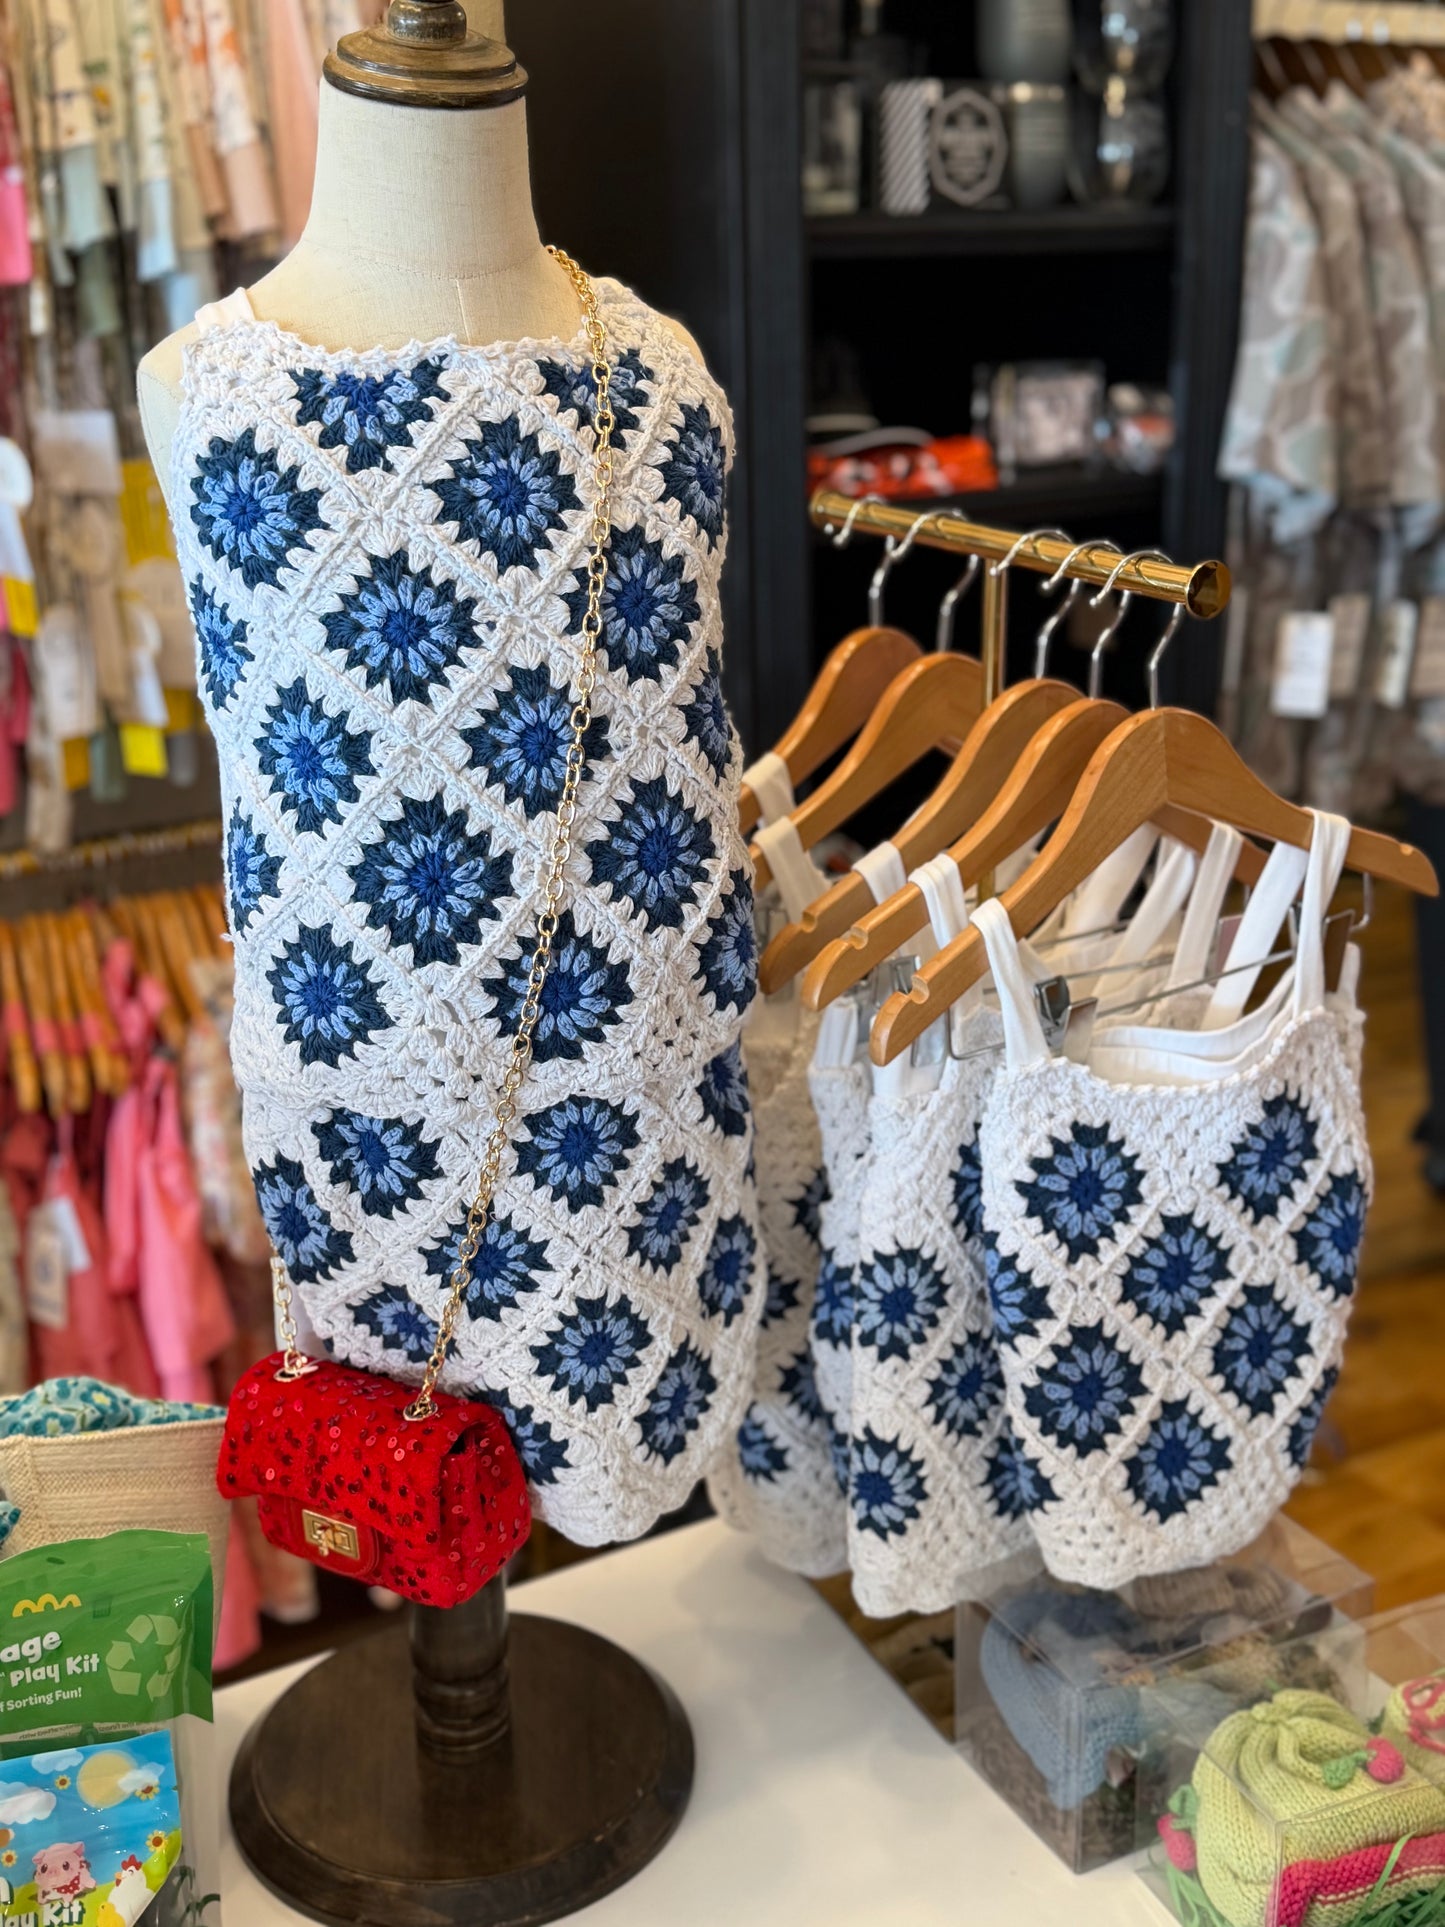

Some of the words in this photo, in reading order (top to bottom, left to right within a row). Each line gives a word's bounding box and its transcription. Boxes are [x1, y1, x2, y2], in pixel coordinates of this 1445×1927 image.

[10, 1663, 60, 1688] Play
[66, 1653, 100, 1675] Kit
[6, 1692, 54, 1711] Sorting
[55, 1687, 82, 1701] Fun!
[43, 1899, 82, 1926] Kit
